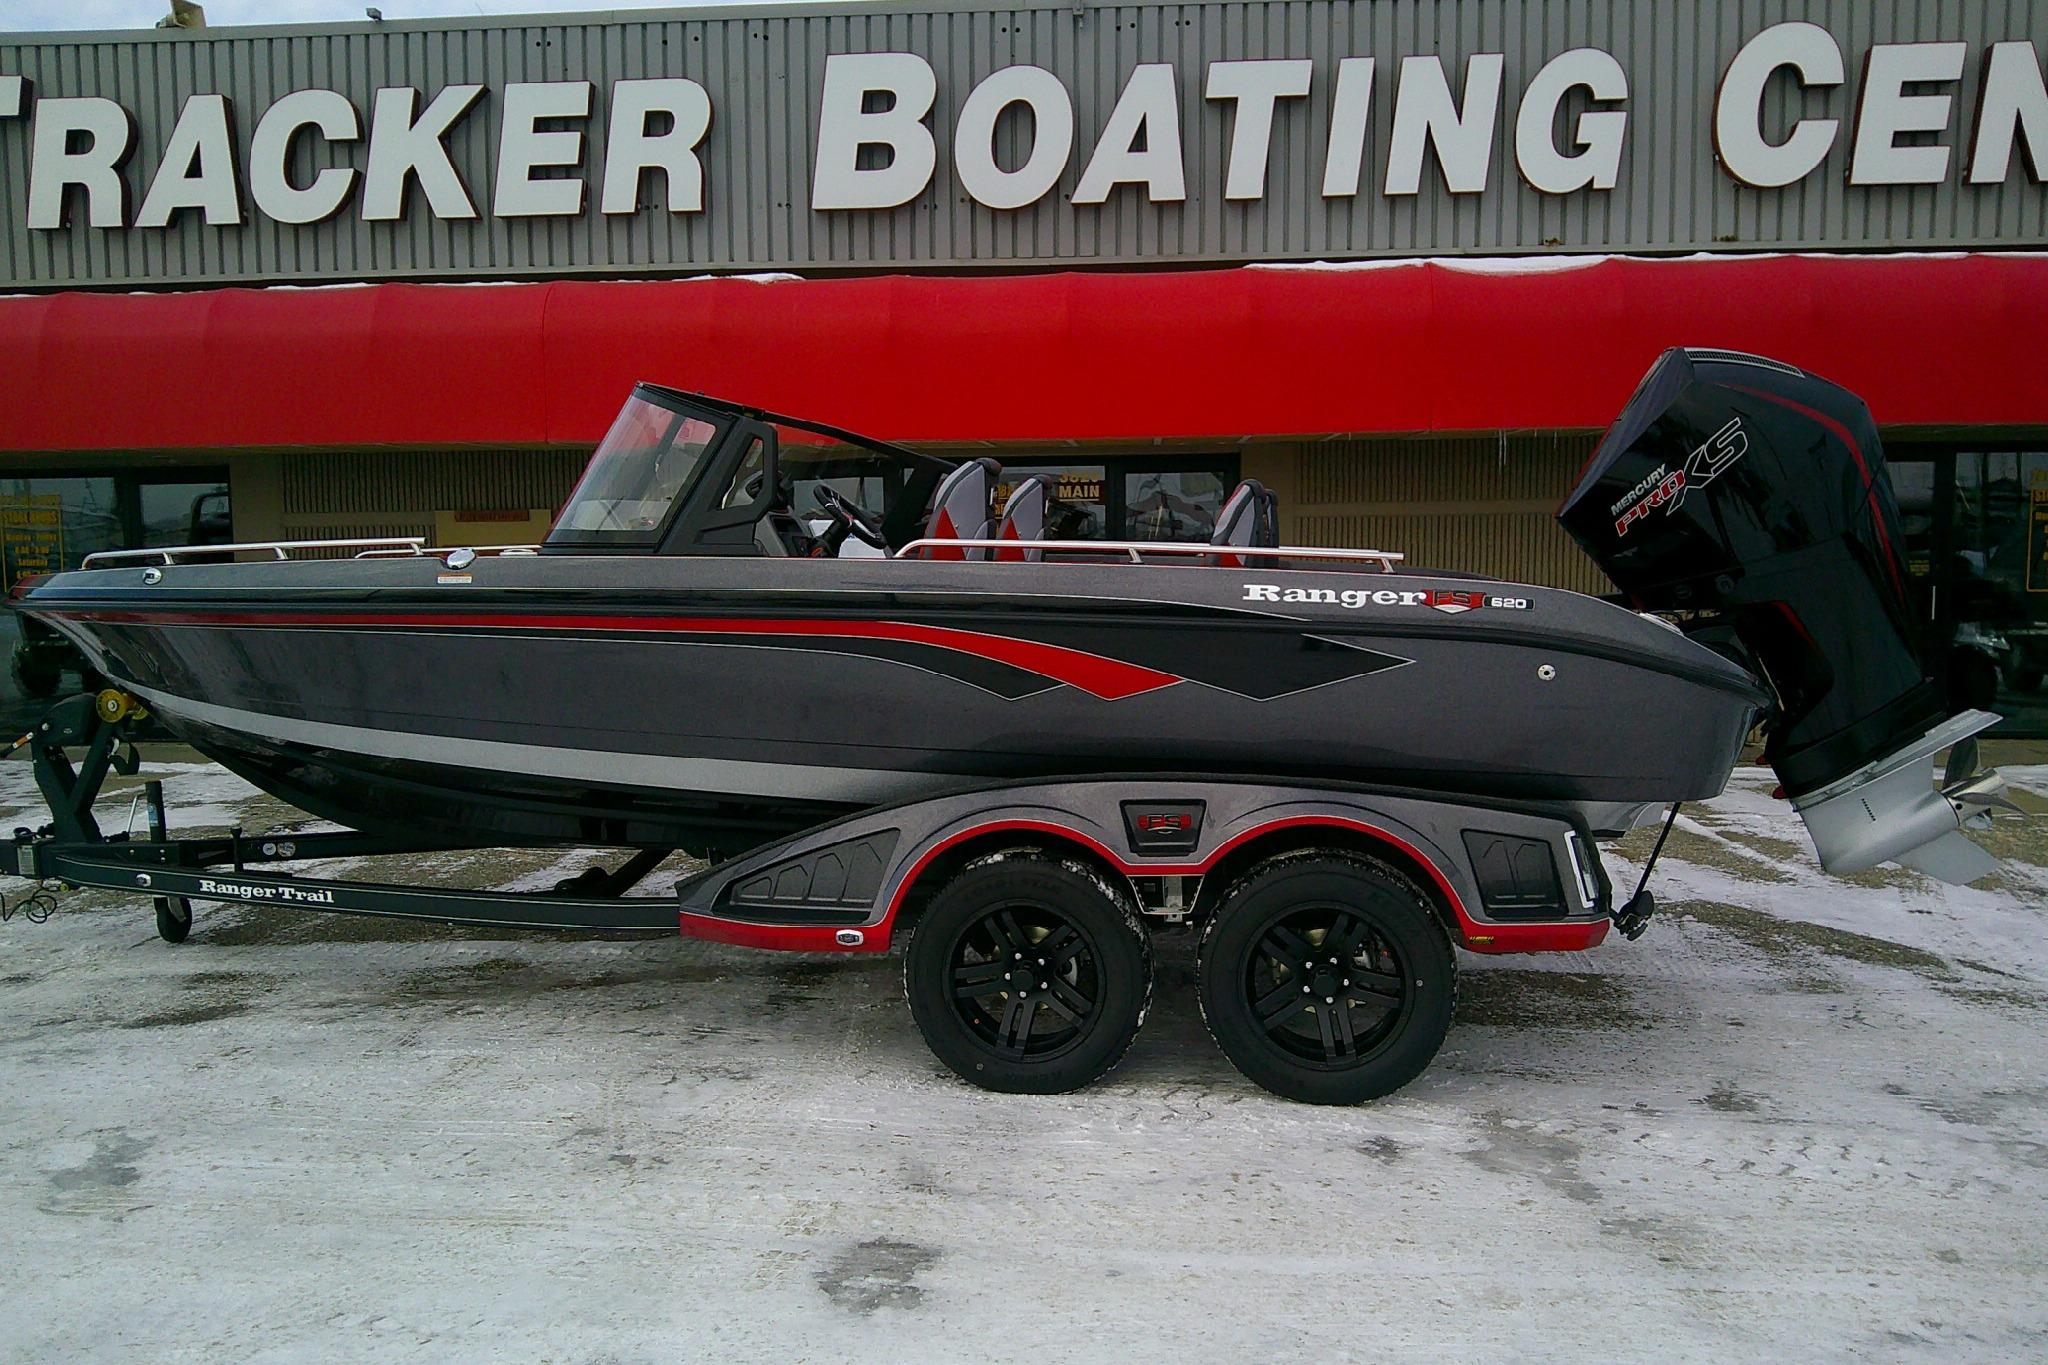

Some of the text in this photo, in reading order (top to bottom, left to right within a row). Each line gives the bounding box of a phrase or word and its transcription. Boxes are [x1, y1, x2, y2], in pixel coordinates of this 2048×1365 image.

[812, 47, 1629, 211] BOATING
[1058, 485, 1100, 498] MAIN
[1610, 463, 1667, 516] MERCURY
[1615, 416, 1749, 537] PRO XS
[1242, 584, 1427, 609] Ranger
[1491, 597, 1527, 609] 620
[199, 879, 335, 904] Ranger Trail
